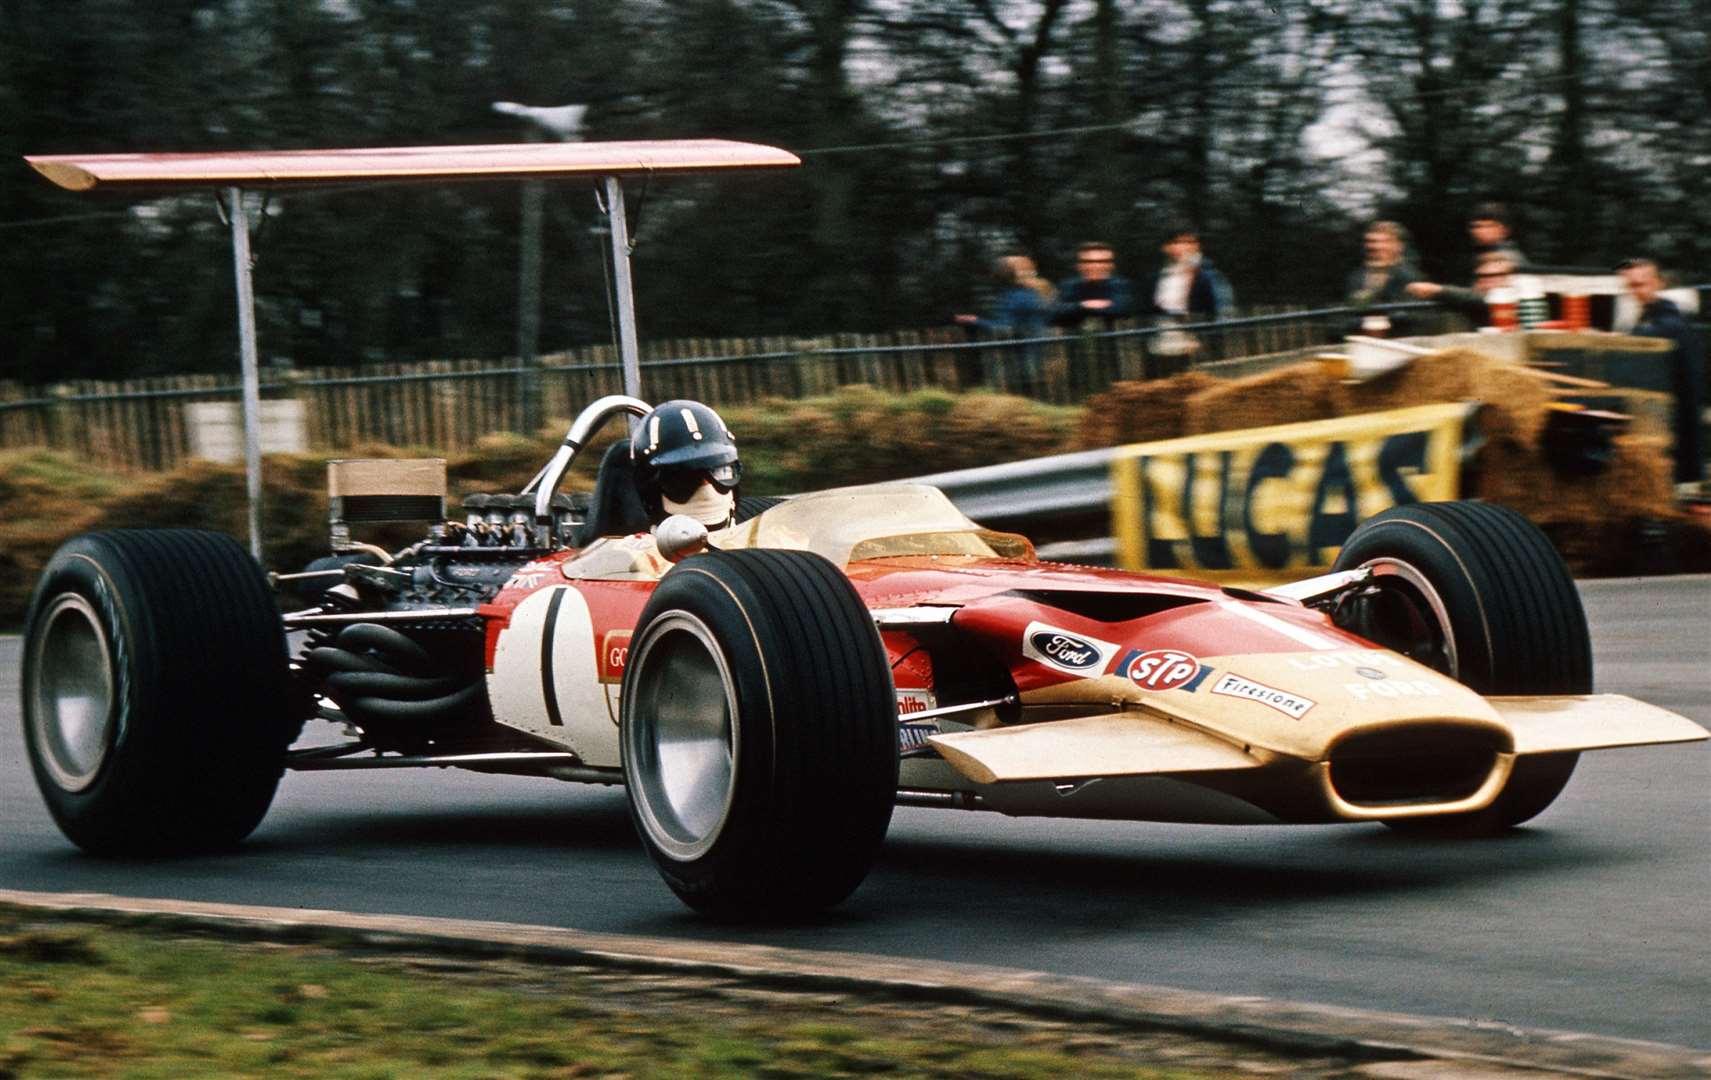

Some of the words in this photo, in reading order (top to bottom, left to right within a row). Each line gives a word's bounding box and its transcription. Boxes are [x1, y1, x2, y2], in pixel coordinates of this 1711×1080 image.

[1142, 431, 1429, 569] LUCAS
[541, 587, 567, 726] 1
[1046, 635, 1091, 664] Ford
[1132, 653, 1193, 686] STP
[1223, 678, 1304, 711] Firestone
[1344, 681, 1440, 700] FORD
